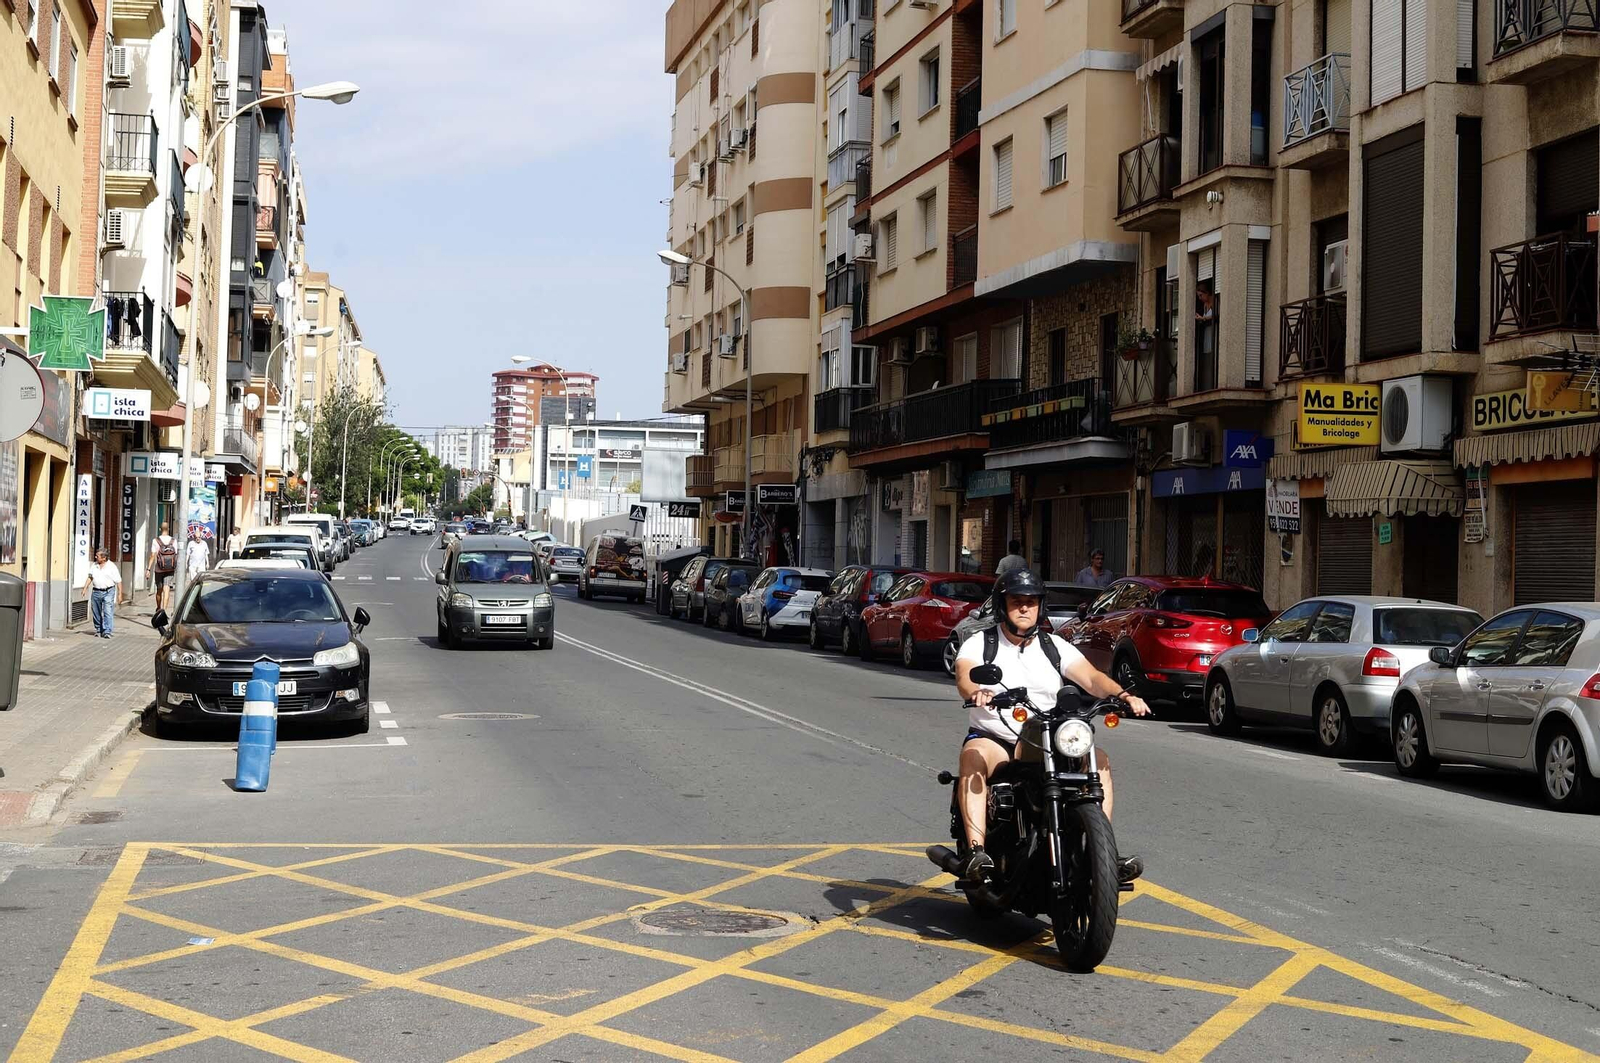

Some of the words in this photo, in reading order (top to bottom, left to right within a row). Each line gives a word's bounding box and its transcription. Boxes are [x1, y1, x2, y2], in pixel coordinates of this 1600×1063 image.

[114, 397, 136, 407] isla
[1303, 389, 1335, 409] Ma
[1342, 389, 1379, 410] Bric
[114, 407, 145, 417] chica
[1307, 417, 1365, 427] Manualidades
[1366, 420, 1373, 429] y
[1322, 428, 1360, 439] Bricolage
[1230, 445, 1258, 459] AXA
[150, 459, 166, 467] isla
[150, 466, 173, 474] chica
[1171, 477, 1185, 494] AXA
[1227, 470, 1242, 490] AXA
[670, 503, 685, 516] 24
[79, 479, 88, 556] ARMARIOS
[122, 484, 132, 553] SUELOS
